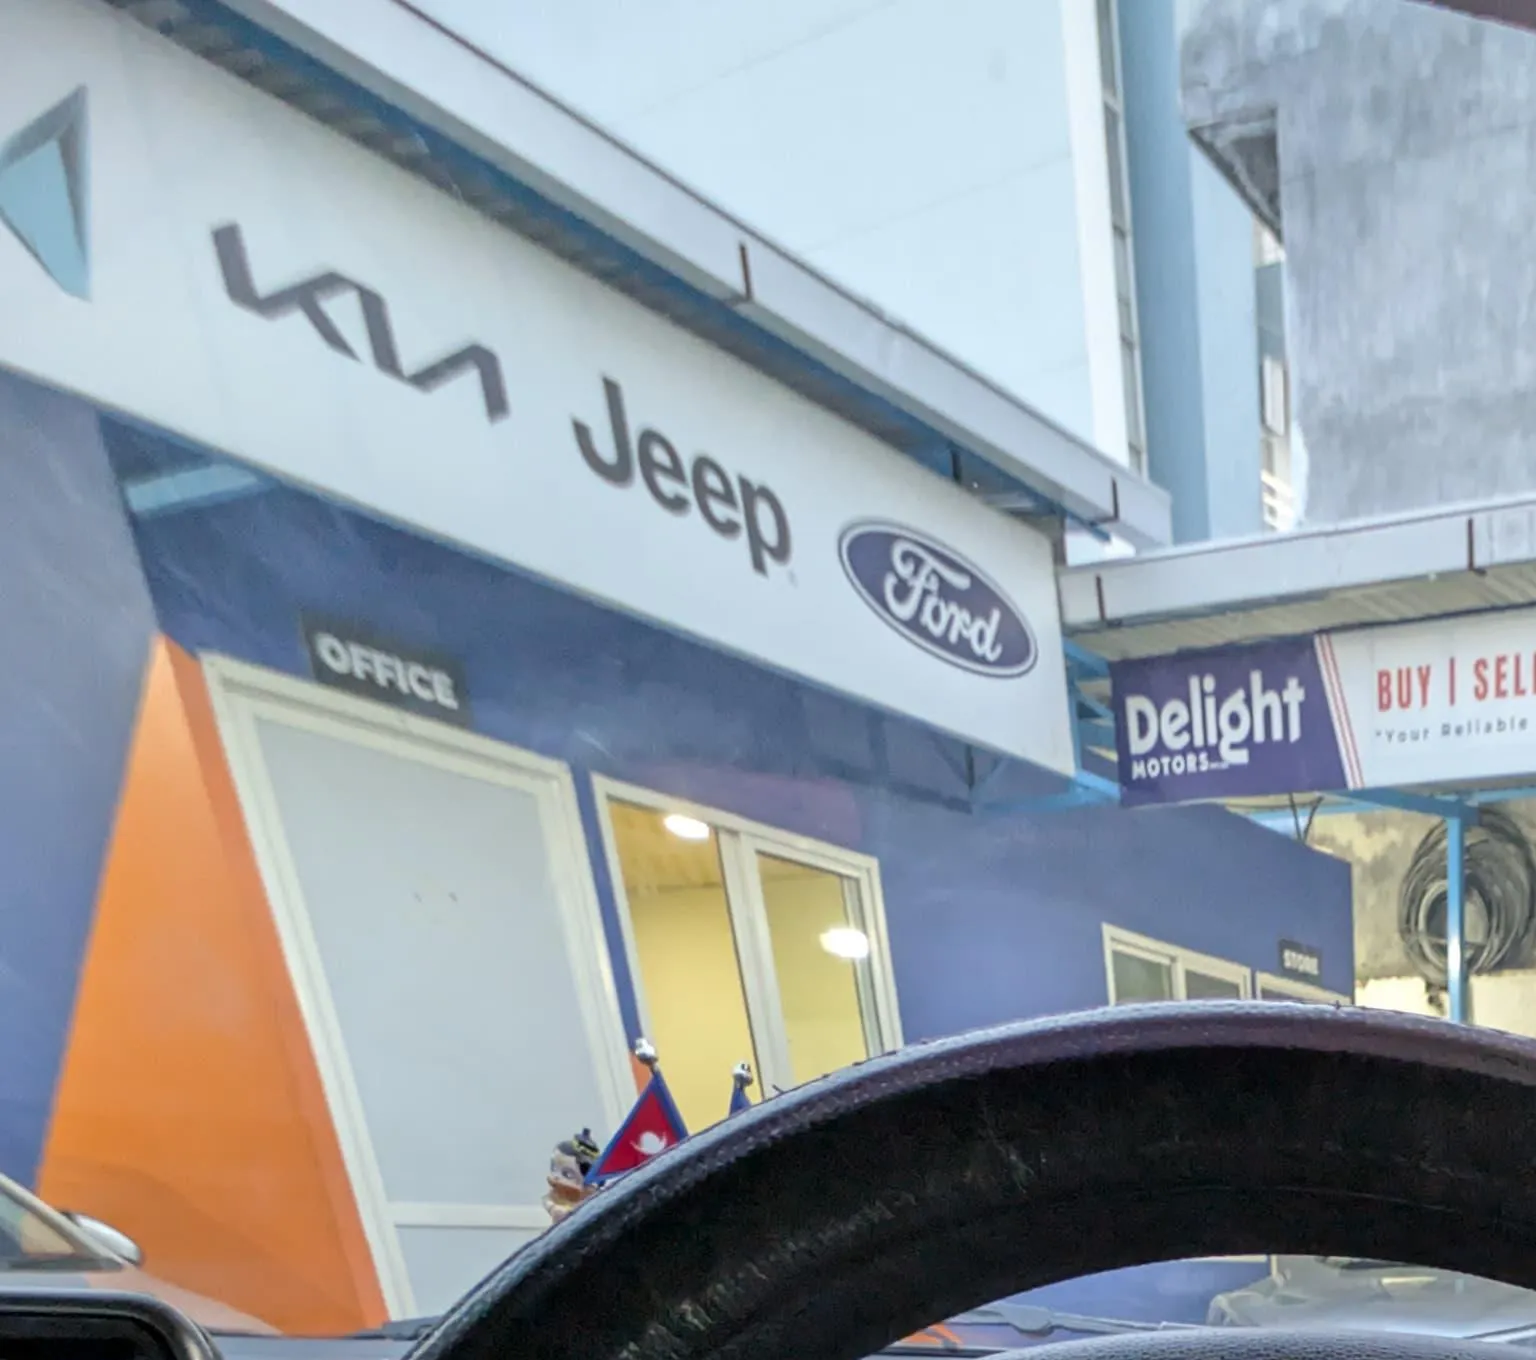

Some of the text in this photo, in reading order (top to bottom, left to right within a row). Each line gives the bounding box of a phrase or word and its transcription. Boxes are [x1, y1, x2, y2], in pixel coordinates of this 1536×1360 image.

[571, 373, 792, 577] Jeep
[884, 538, 1002, 662] Ford
[314, 631, 459, 710] OFFICE
[1377, 665, 1432, 712] BUY
[1125, 670, 1305, 764] Delight
[1441, 716, 1528, 737] Reliable
[1132, 752, 1209, 780] MOTORS
